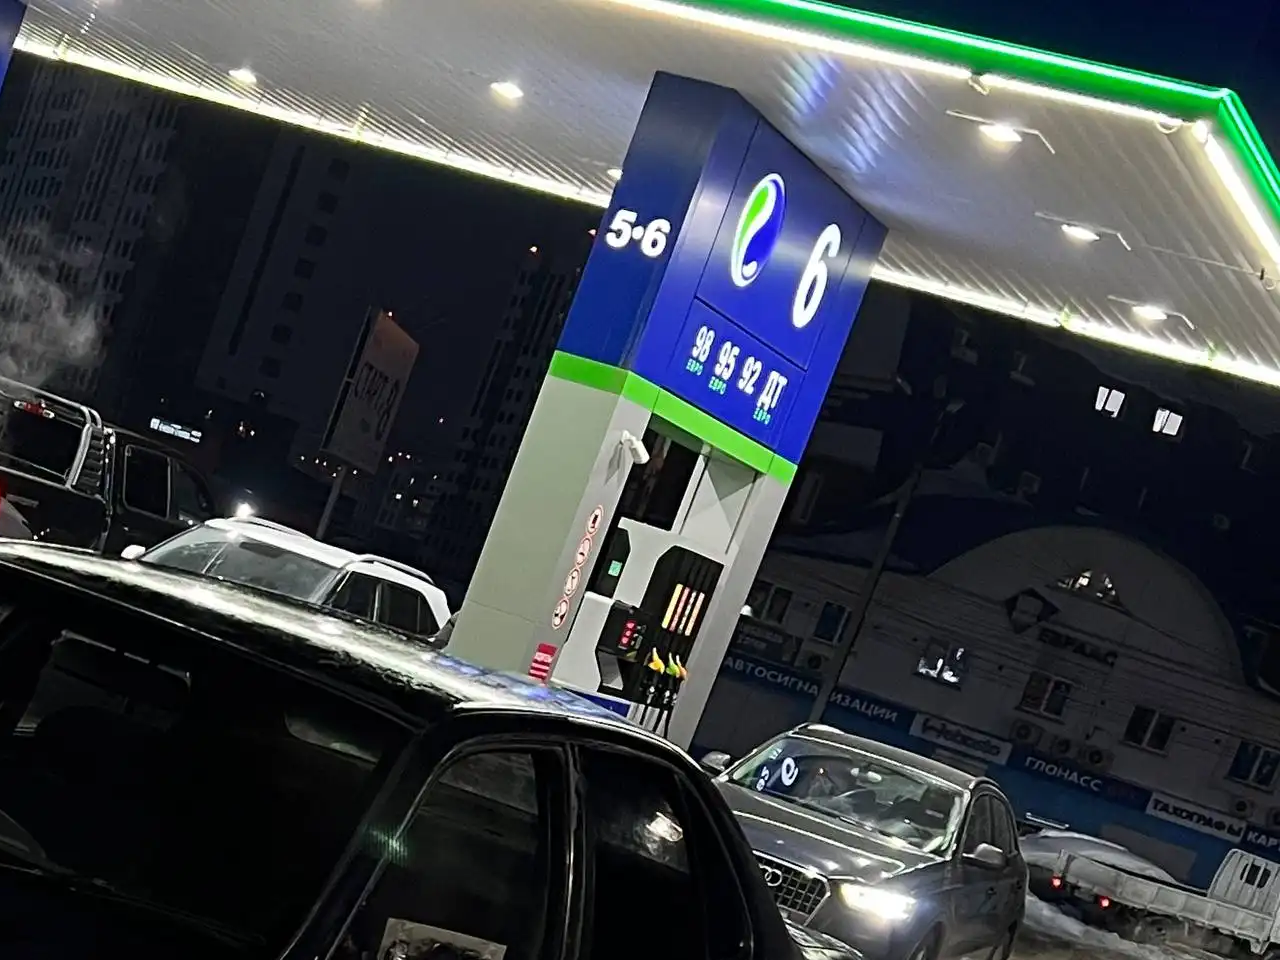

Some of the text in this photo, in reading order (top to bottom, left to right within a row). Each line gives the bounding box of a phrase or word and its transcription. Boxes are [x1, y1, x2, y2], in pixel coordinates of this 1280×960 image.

[792, 223, 841, 328] 6
[691, 325, 762, 395] 98 95 92
[756, 370, 788, 412] ДТ
[724, 655, 899, 723] АВТОСИГНАИЗАЦИИ
[1025, 756, 1103, 793] ГЛОНАСС
[1246, 830, 1280, 853] КАР
